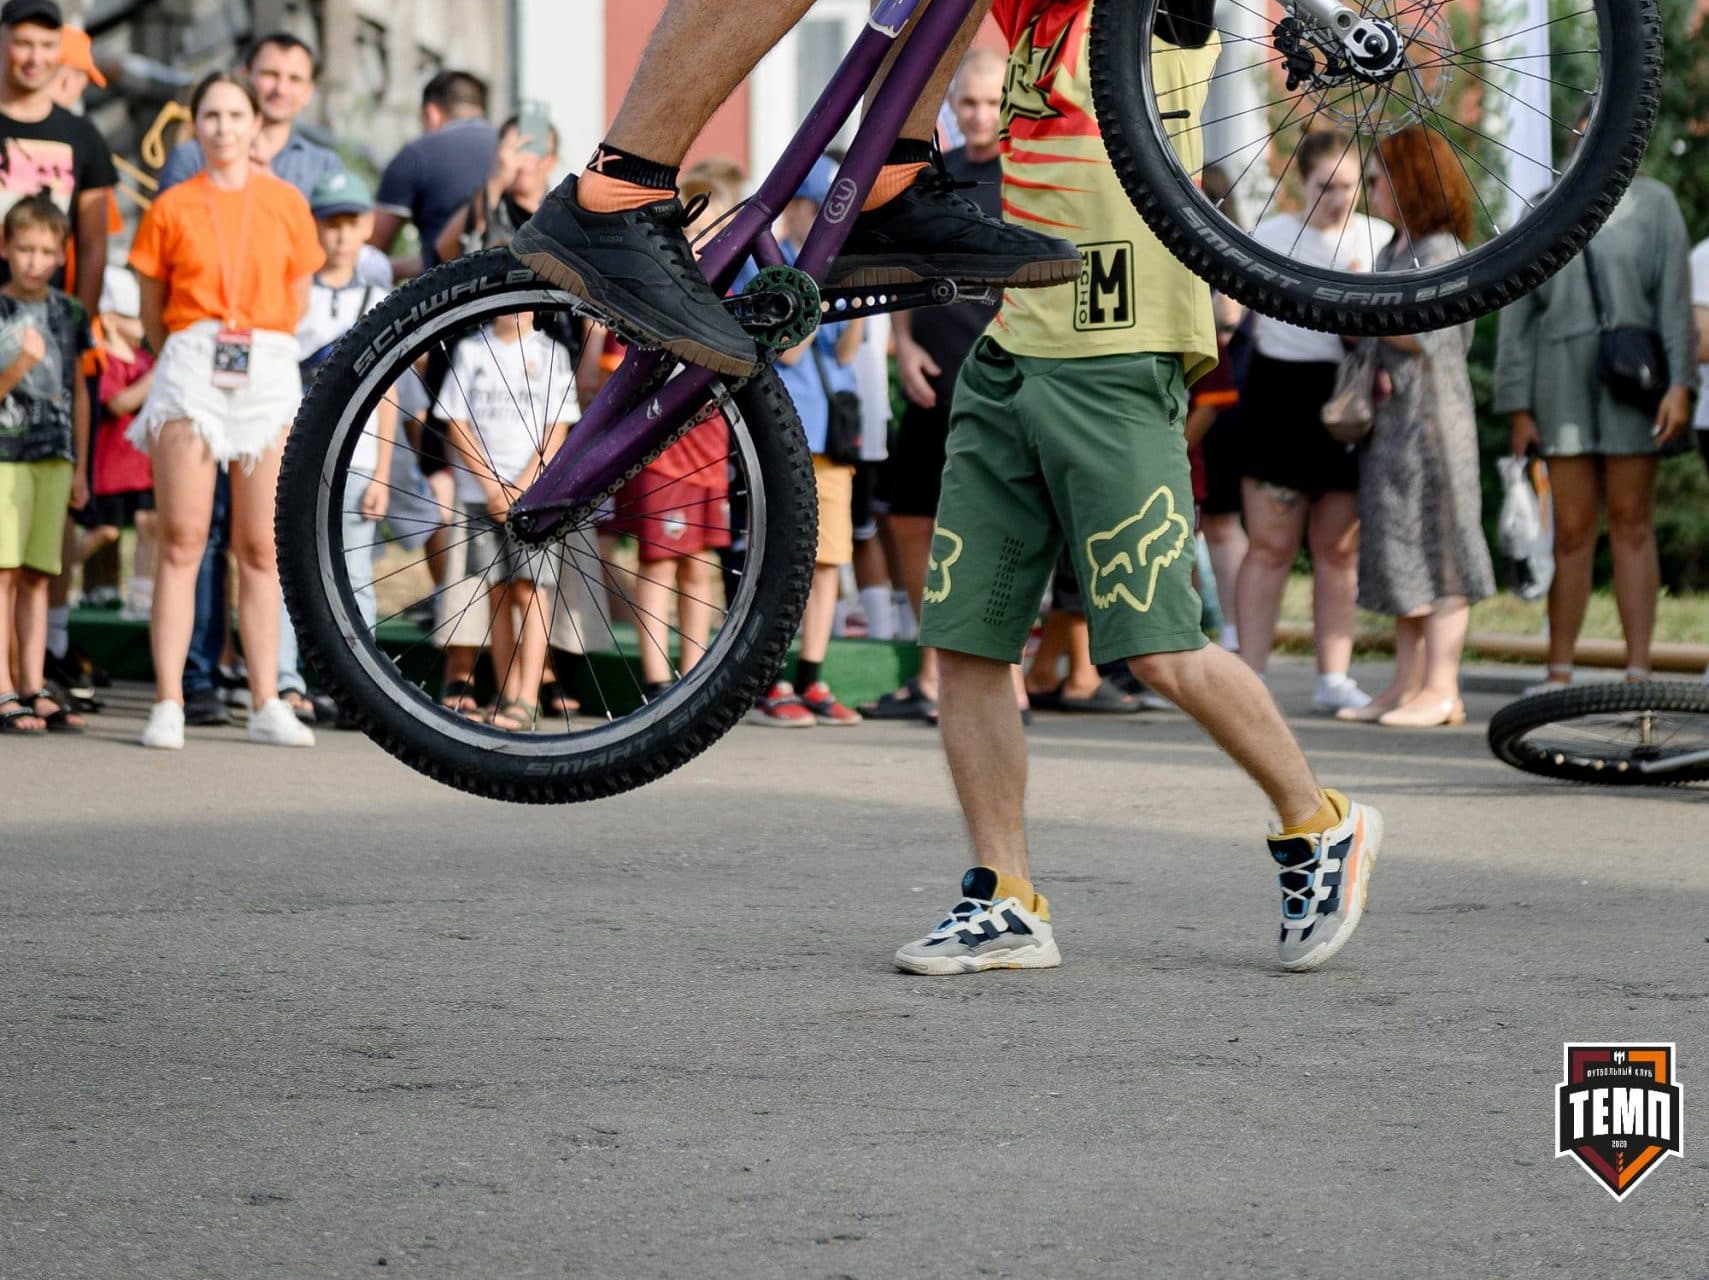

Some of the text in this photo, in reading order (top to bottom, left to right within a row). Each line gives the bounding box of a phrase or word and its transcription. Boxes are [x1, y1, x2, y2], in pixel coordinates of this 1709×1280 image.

[1180, 206, 1300, 288] SMART
[1312, 286, 1404, 306] SAM
[353, 270, 535, 377] SCHWALB
[526, 734, 653, 776] SMART
